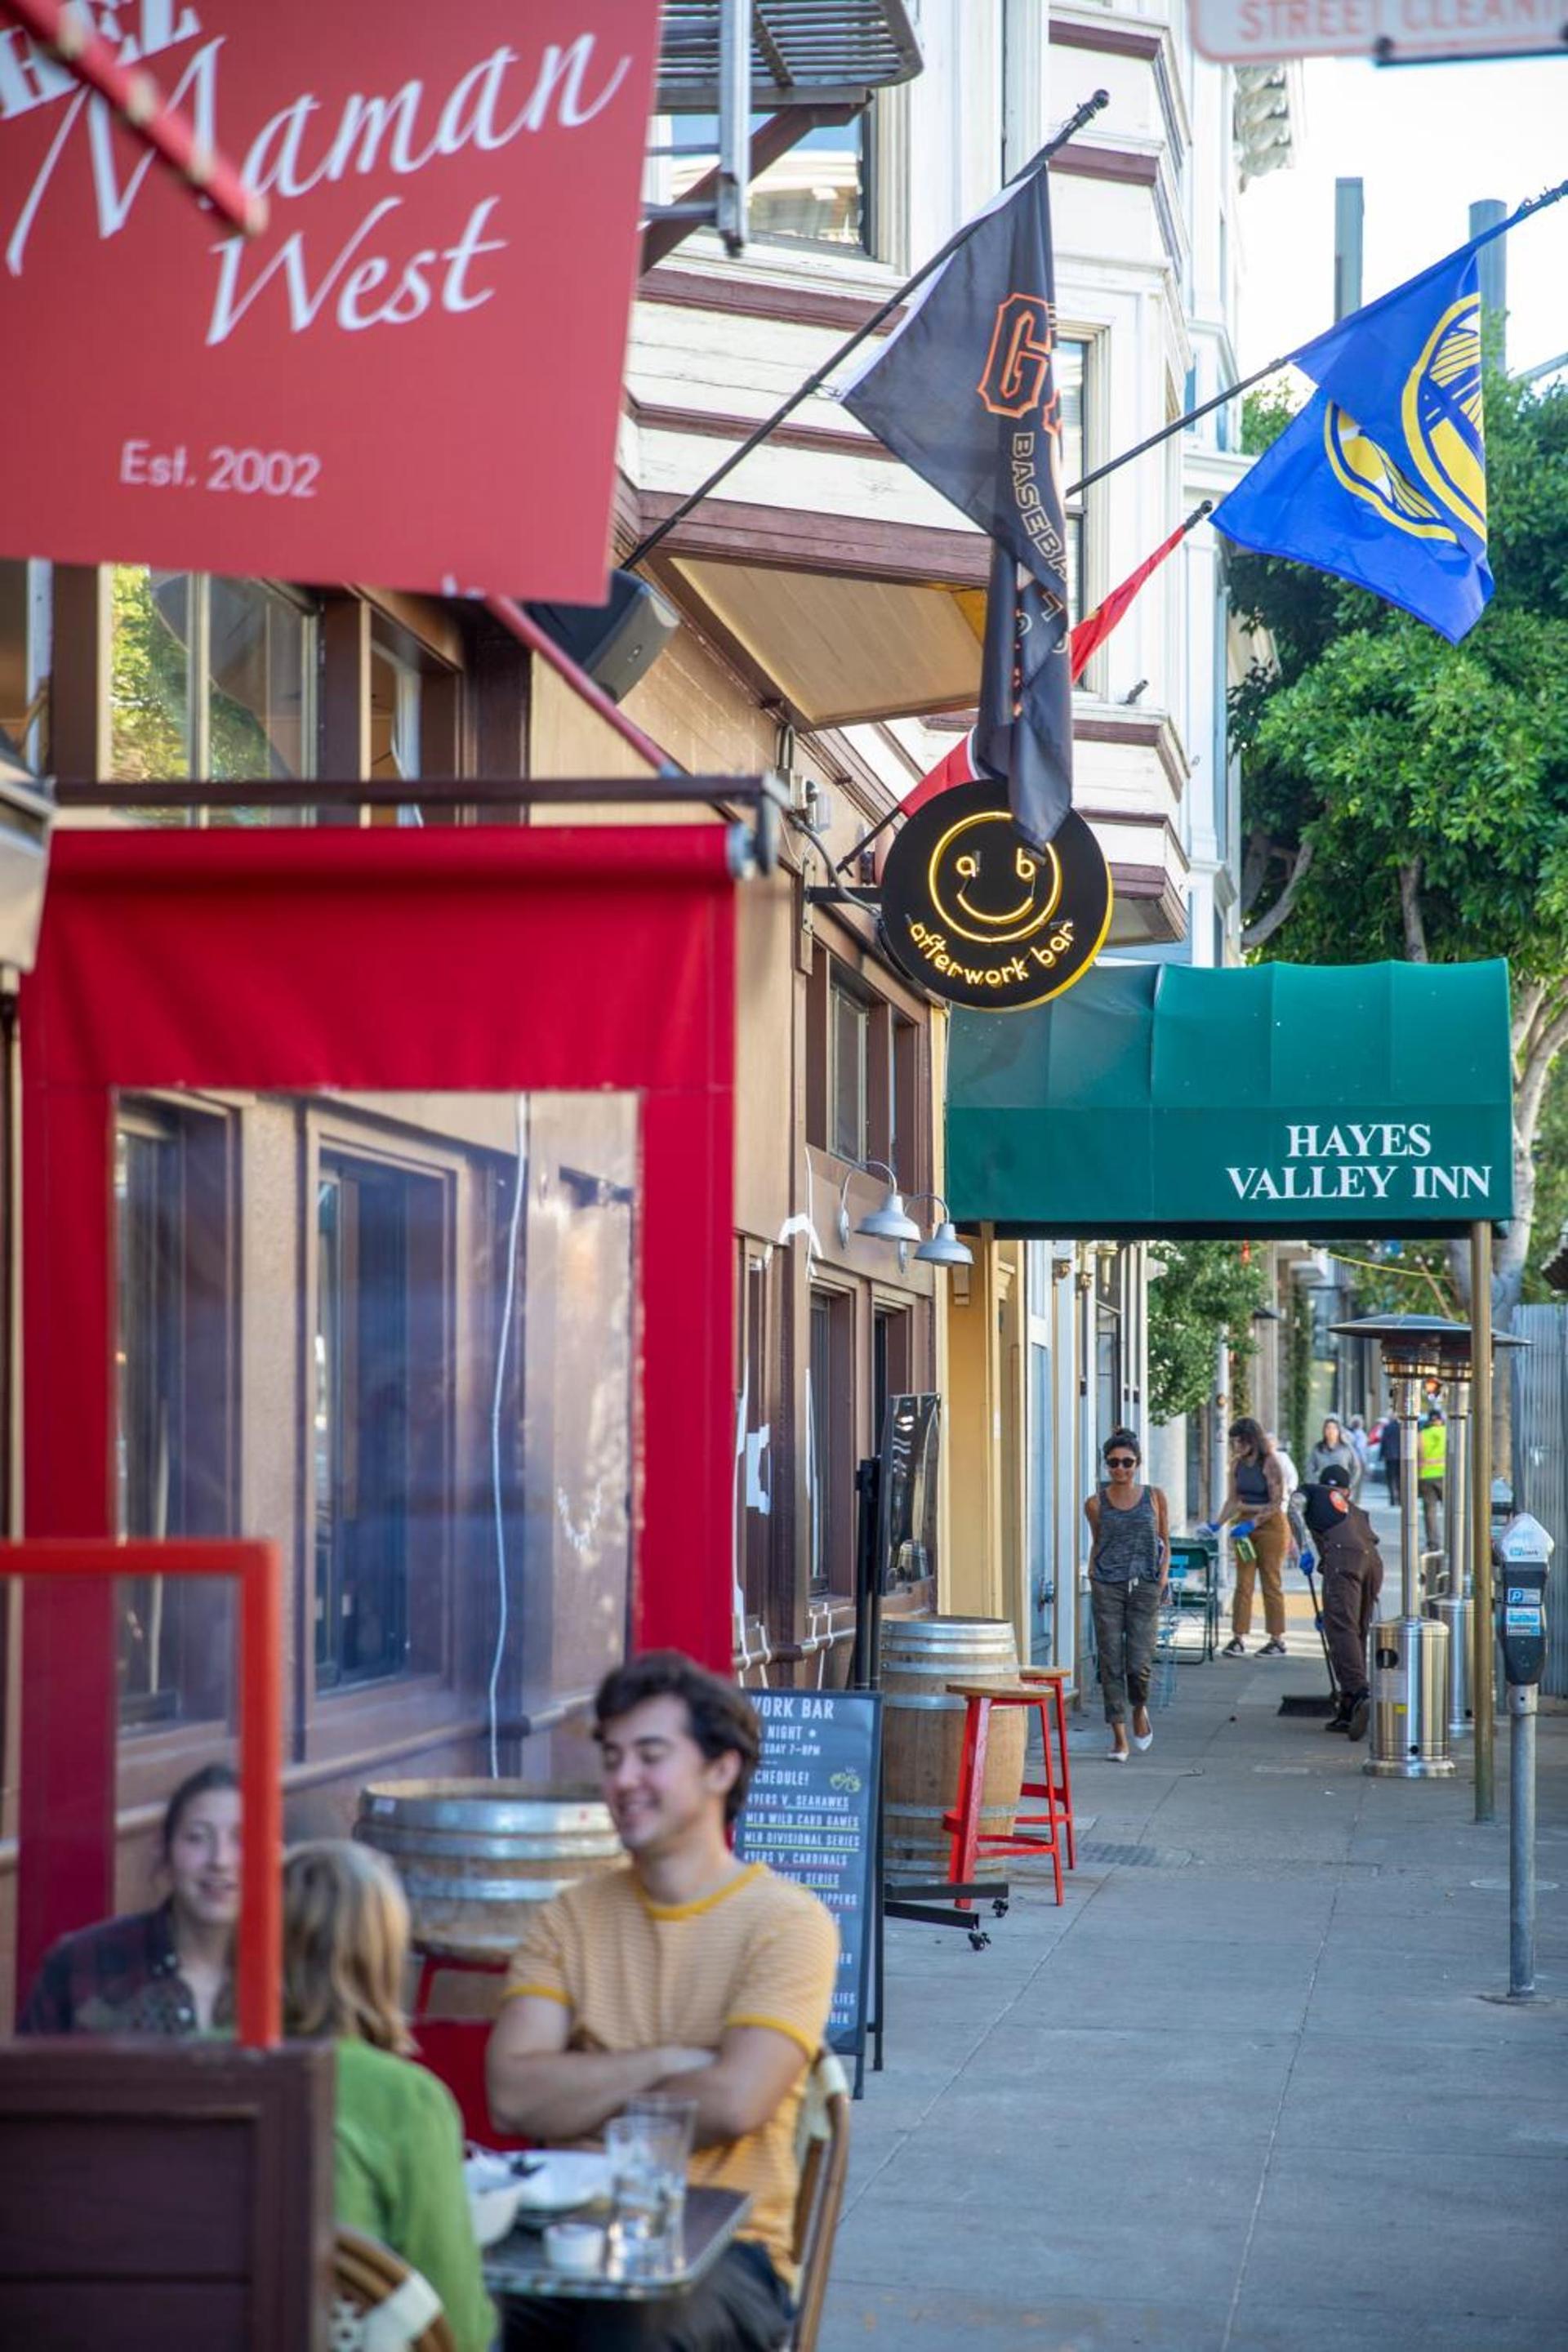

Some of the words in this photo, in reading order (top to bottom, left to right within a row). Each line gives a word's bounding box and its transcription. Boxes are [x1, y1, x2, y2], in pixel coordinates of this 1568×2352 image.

[5, 33, 631, 277] Maman
[206, 195, 509, 346] West
[120, 439, 196, 487] Est.
[207, 445, 321, 497] 2002
[910, 923, 1030, 985] afterwork
[1030, 921, 1074, 967] bar
[1286, 1124, 1431, 1158] HAYES
[1227, 1166, 1398, 1200] VALLEY
[1412, 1165, 1492, 1199] INN
[801, 1698, 835, 1719] BAR
[767, 1725, 803, 1740] NIGHT
[752, 1769, 809, 1786] CHEDULE!
[796, 1795, 849, 1807] SEAHAWKS
[746, 1812, 764, 1824] MLB
[768, 1813, 793, 1824] WILD
[796, 1814, 822, 1826] CARD
[744, 1831, 763, 1843] MLB
[766, 1832, 822, 1846] DIVISIONAL
[826, 1834, 860, 1847] SERIES
[792, 1853, 847, 1866] CARDINALS
[815, 1892, 858, 1906] LIPPERS
